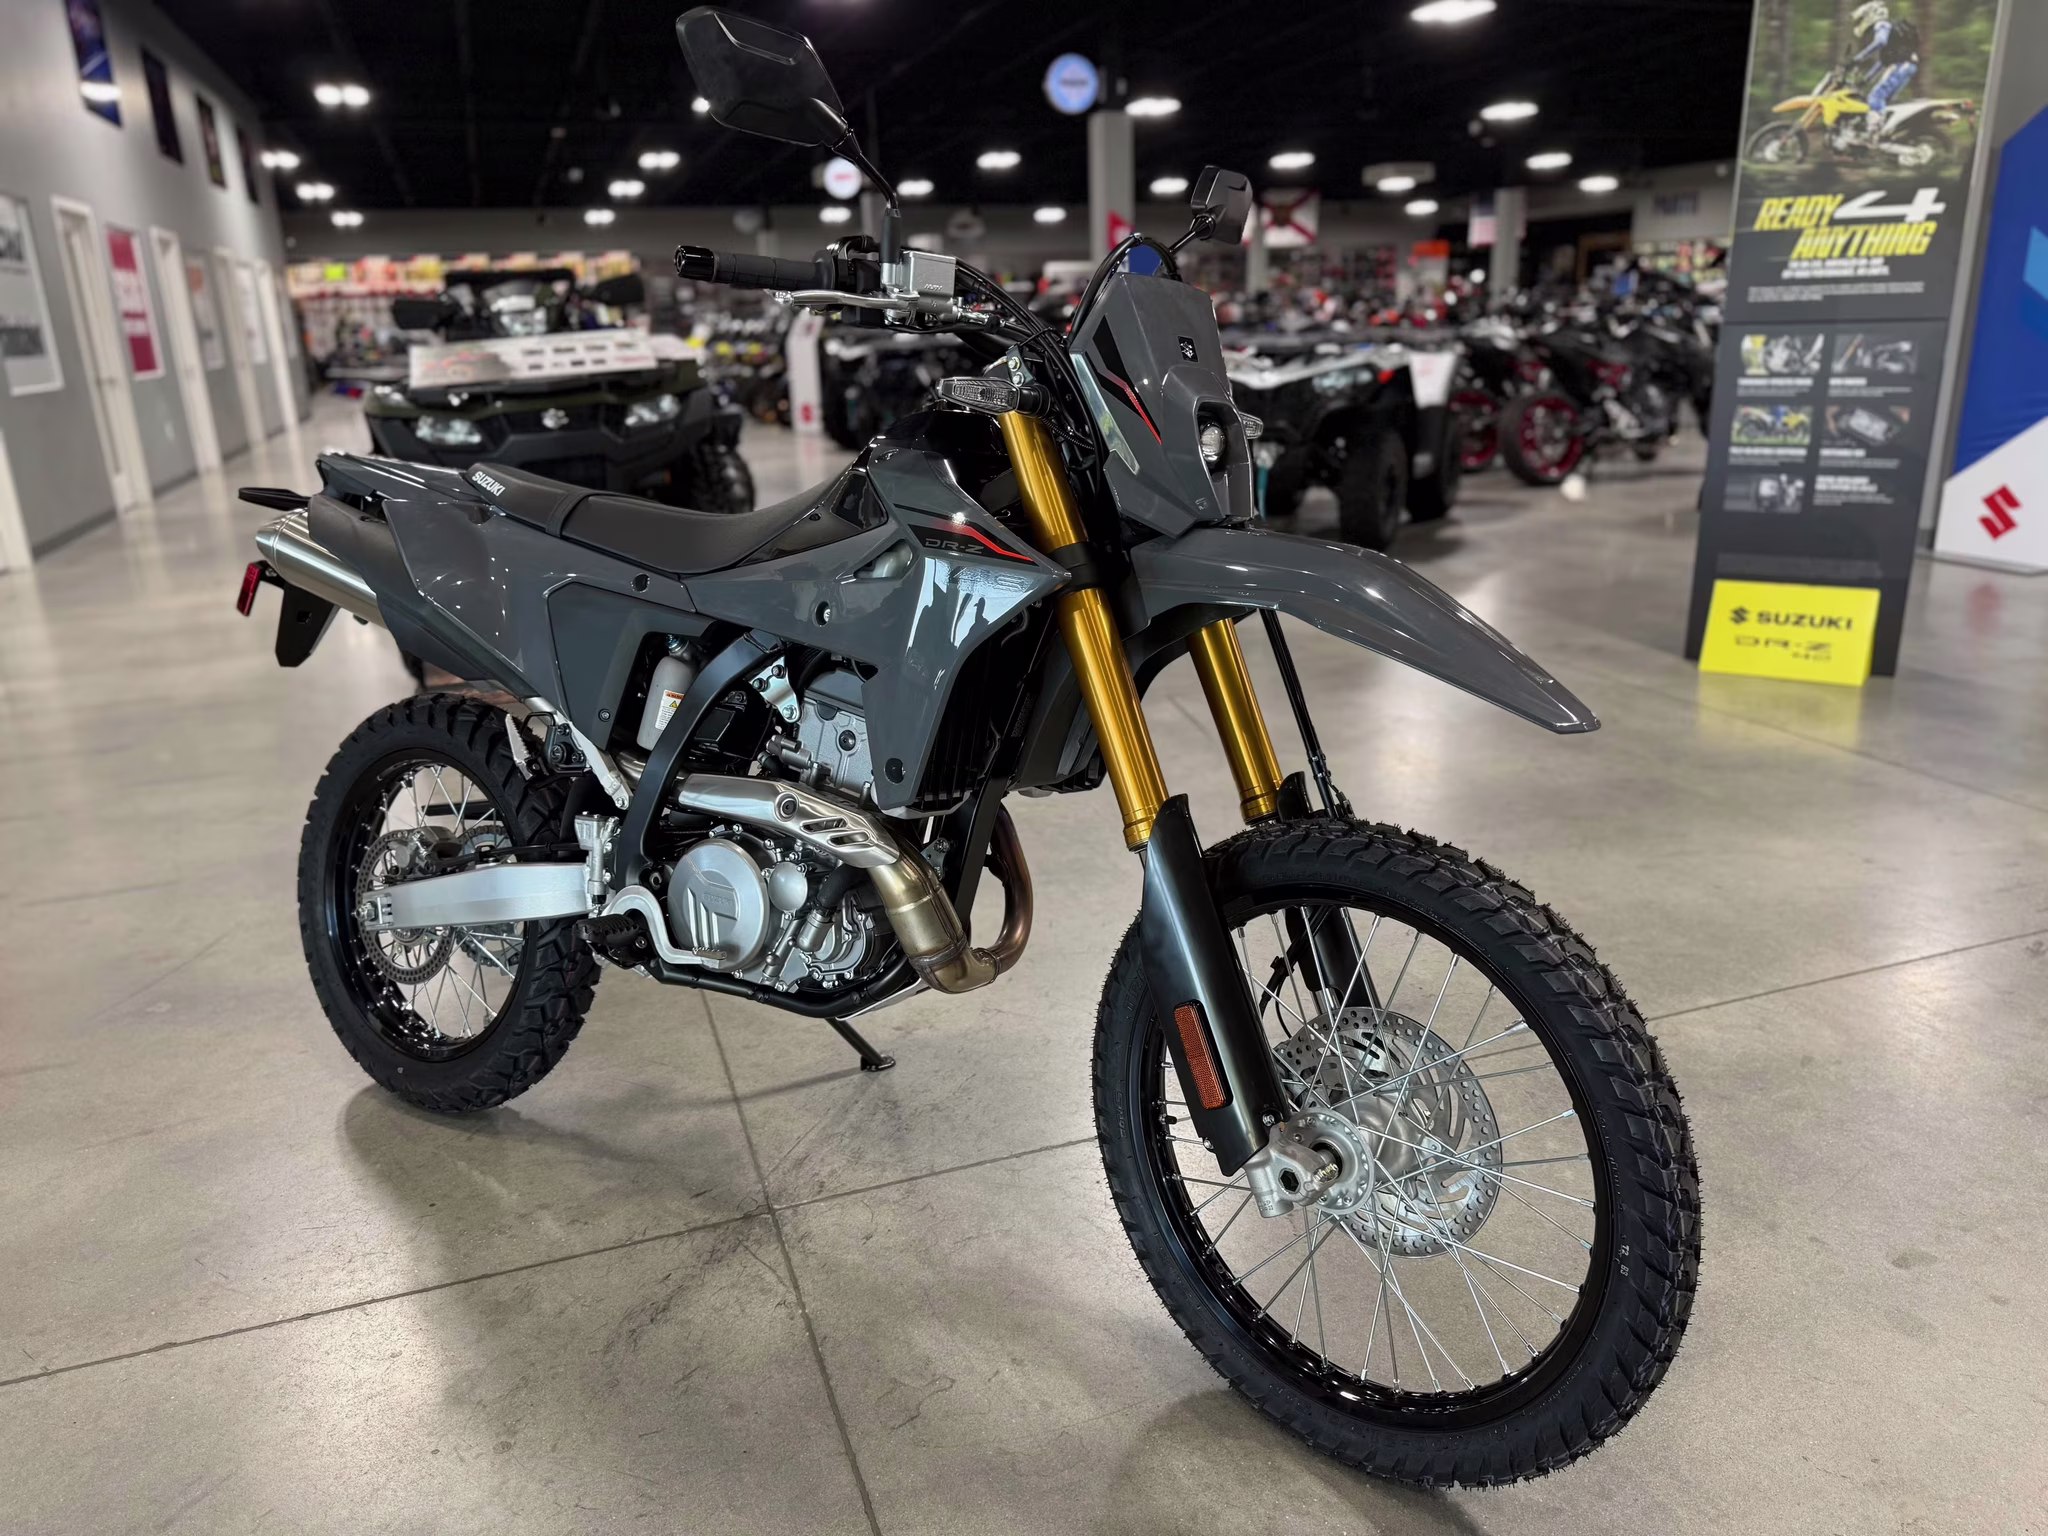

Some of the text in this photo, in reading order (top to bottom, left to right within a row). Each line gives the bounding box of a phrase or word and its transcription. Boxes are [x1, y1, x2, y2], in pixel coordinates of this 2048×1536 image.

[1754, 188, 1945, 231] READY 4
[1791, 222, 1937, 260] ANYTHING
[472, 471, 506, 497] SUZUKI
[925, 538, 984, 554] DR-Z
[1757, 611, 1853, 631] SUZUKI
